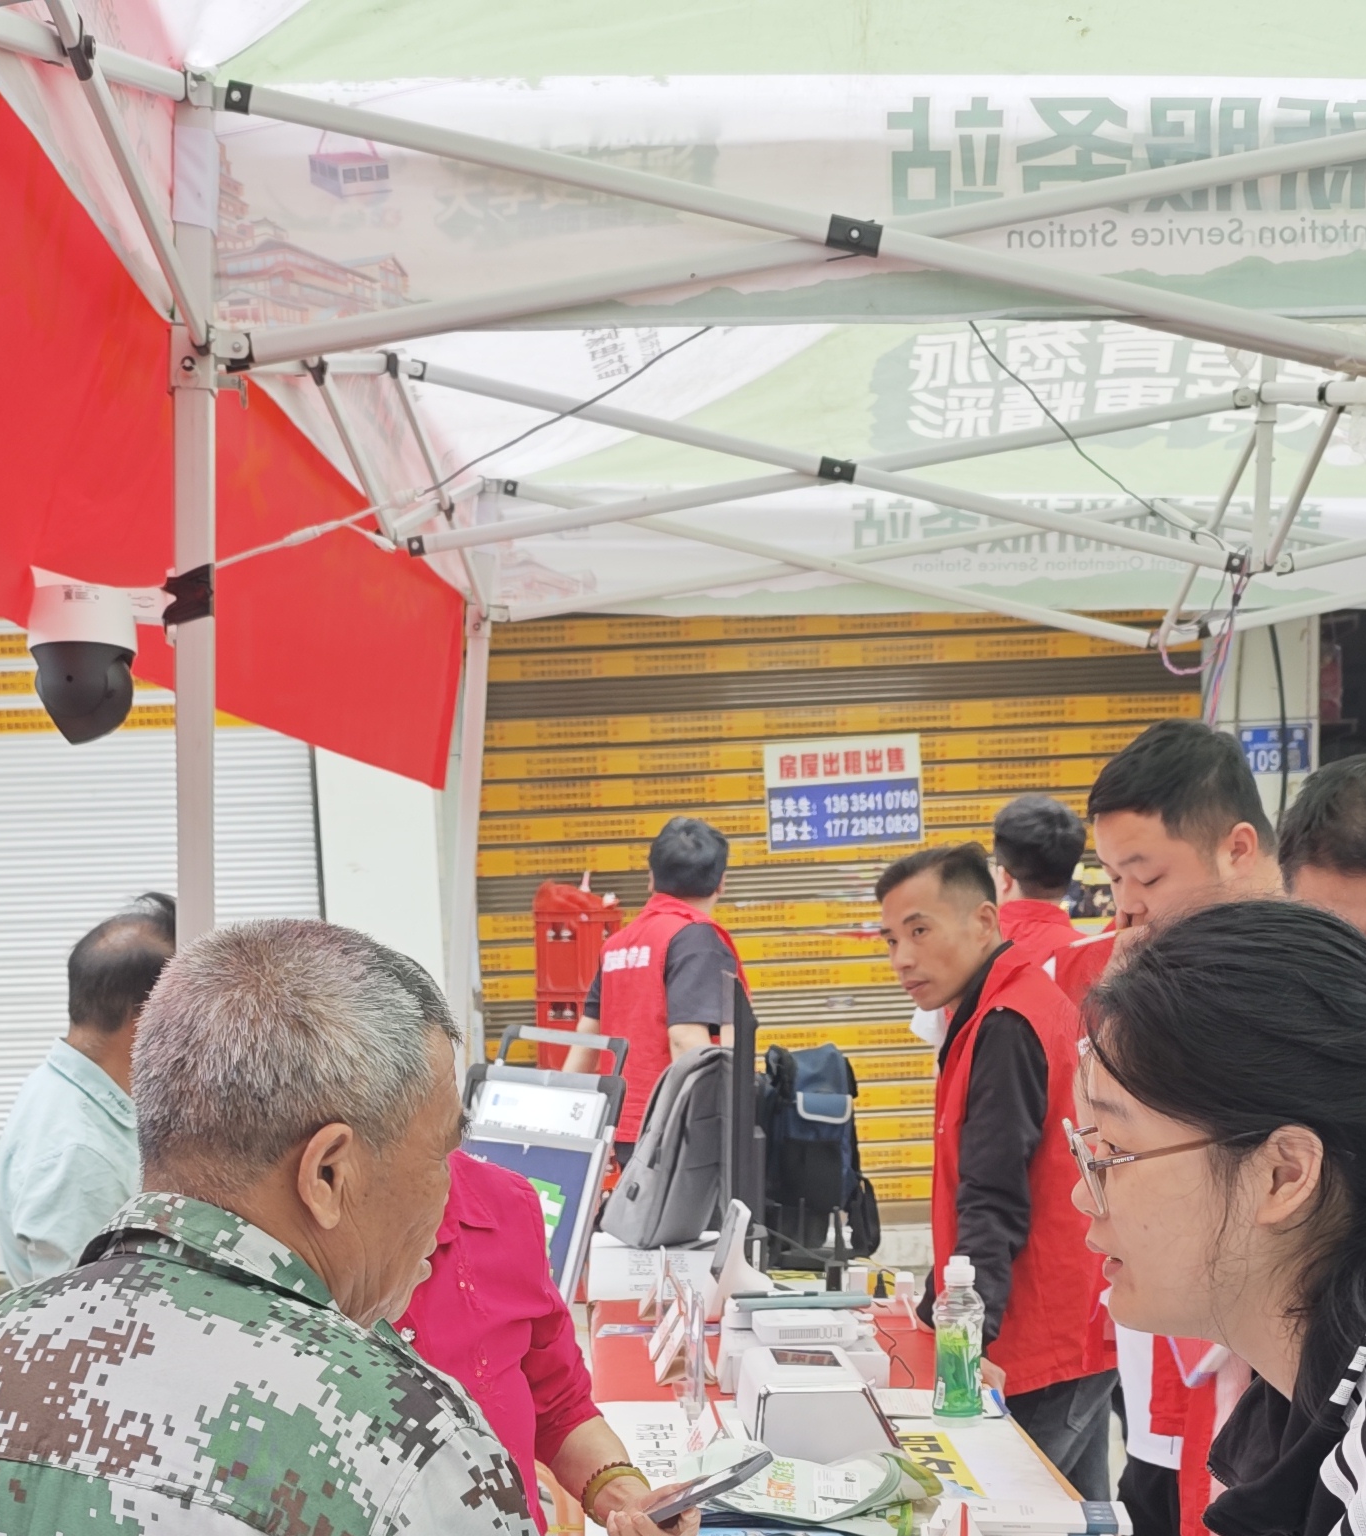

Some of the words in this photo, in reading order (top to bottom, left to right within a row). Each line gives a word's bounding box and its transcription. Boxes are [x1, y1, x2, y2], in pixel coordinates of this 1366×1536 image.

[779, 747, 905, 780] 房屋出租出售
